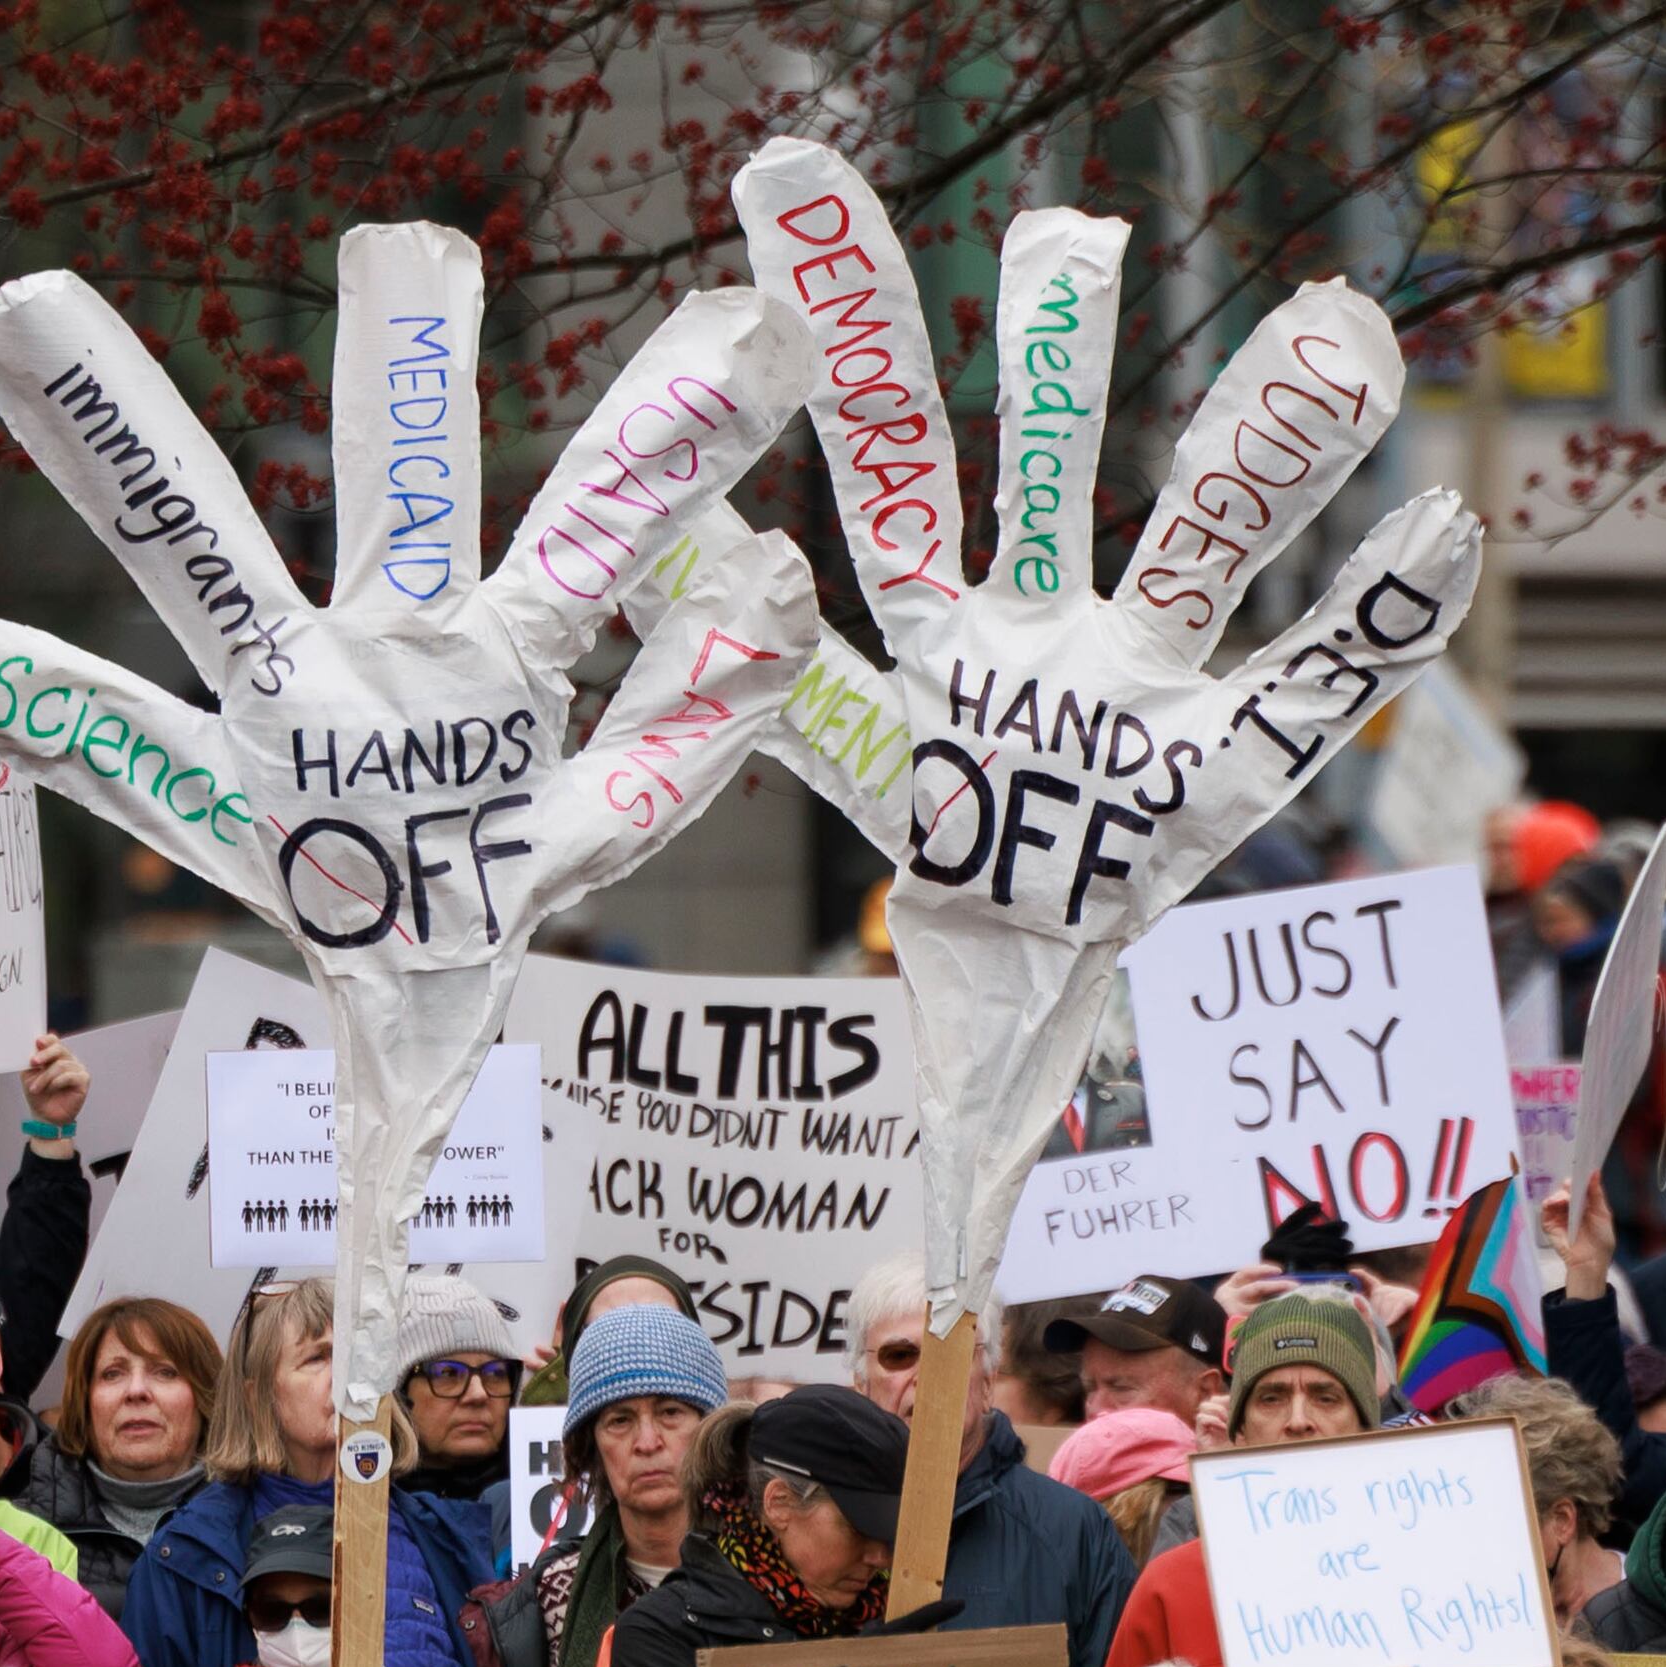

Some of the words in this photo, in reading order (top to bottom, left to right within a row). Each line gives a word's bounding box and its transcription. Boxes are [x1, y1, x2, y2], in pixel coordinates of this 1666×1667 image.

[778, 193, 960, 601] DEMOCRACY
[382, 315, 456, 601] MEDICAID
[536, 376, 738, 599] USAID
[1138, 335, 1370, 631] JUDGES
[291, 709, 536, 798] HANDS
[605, 626, 781, 831] LAWS
[948, 658, 1203, 816] HANDS
[276, 793, 533, 948] OFF
[908, 738, 1156, 926] OFF
[1191, 899, 1402, 1022] JUST
[578, 989, 699, 1097] ALL
[703, 1005, 881, 1101] THIS
[1228, 1016, 1402, 1132] SAY
[309, 1105, 333, 1119] OF
[443, 1145, 505, 1162] OWER"
[637, 1092, 680, 1137] YOU
[688, 1102, 788, 1150] DIDNT
[801, 1108, 904, 1159] WANT
[247, 1151, 295, 1166] THAN
[301, 1150, 334, 1165] THE
[689, 1166, 891, 1234] WOMAN
[1063, 1160, 1137, 1196] DER
[659, 1227, 729, 1264] FOR
[1044, 1194, 1191, 1247] FUHRER
[347, 1444, 359, 1452] NO
[1215, 1470, 1337, 1534] Trans
[1364, 1468, 1474, 1531] rights
[1318, 1543, 1380, 1580] are
[1237, 1600, 1391, 1662] Human
[1400, 1573, 1534, 1652] Rights!
